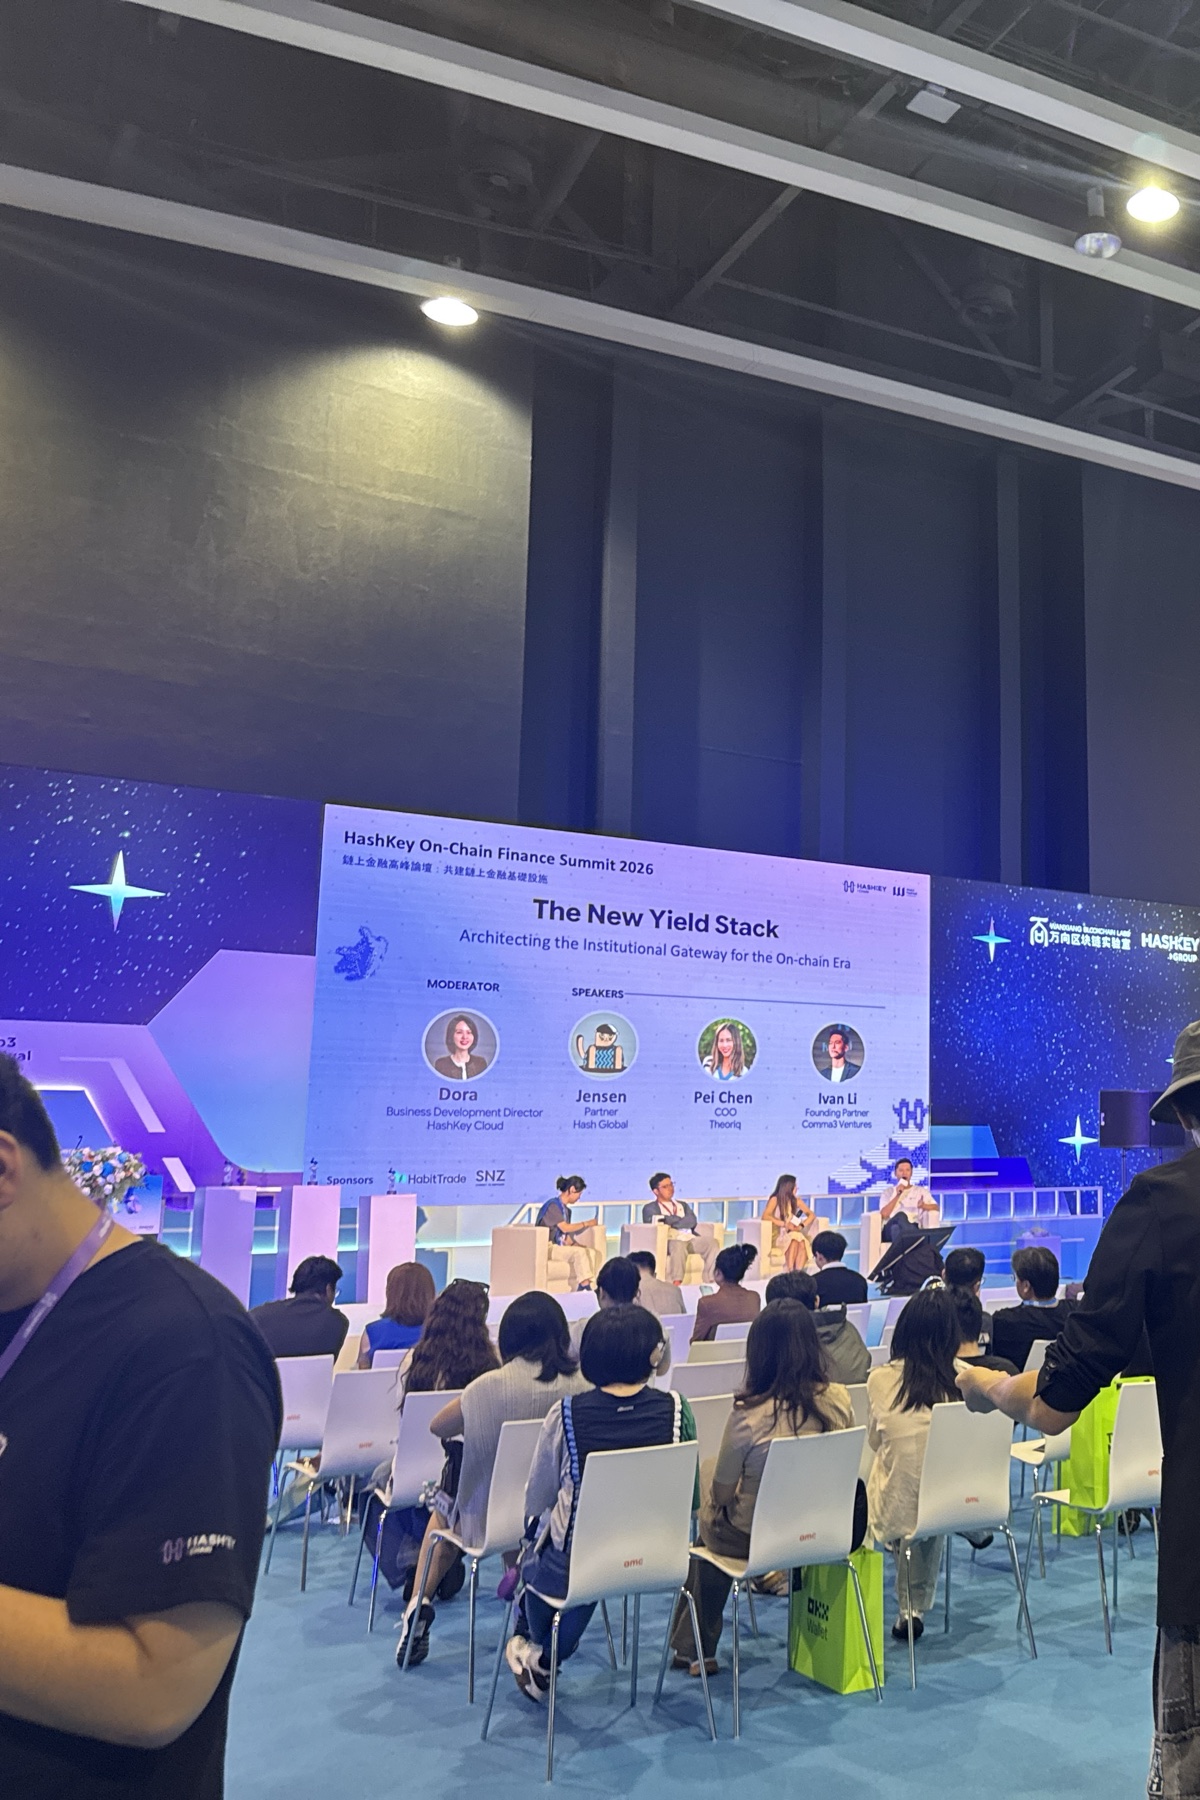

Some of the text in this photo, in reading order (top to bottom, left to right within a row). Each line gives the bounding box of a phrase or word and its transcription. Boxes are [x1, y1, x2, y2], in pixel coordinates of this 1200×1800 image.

[344, 830, 654, 875] HashKey On-Chain Finance Summit 2026
[533, 898, 780, 939] The New Yield Stack
[1141, 932, 1200, 952] HASHKEY
[459, 929, 851, 969] Architecting the Institutional Gateway for the On-chain Era
[1172, 953, 1198, 963] GROUP
[427, 978, 500, 993] MODERATOR
[571, 987, 624, 999] SPEAKERS
[438, 1087, 478, 1101] Dora
[575, 1089, 627, 1103] Jensen
[694, 1091, 753, 1104] Pei Chen
[818, 1093, 857, 1105] Ivan Li
[386, 1106, 544, 1120] Business Development Director
[584, 1106, 618, 1117] Partner
[714, 1107, 737, 1117] COO
[805, 1108, 870, 1119] Founding Partner
[426, 1120, 504, 1133] HashKey Cloud
[573, 1119, 629, 1130] Hash Global
[709, 1119, 742, 1131] Theoriq
[802, 1119, 872, 1129] Comma3 Ventures
[326, 1176, 374, 1186] Sponsors
[408, 1173, 467, 1184] HabitTrade
[475, 1169, 506, 1182] SNZ
